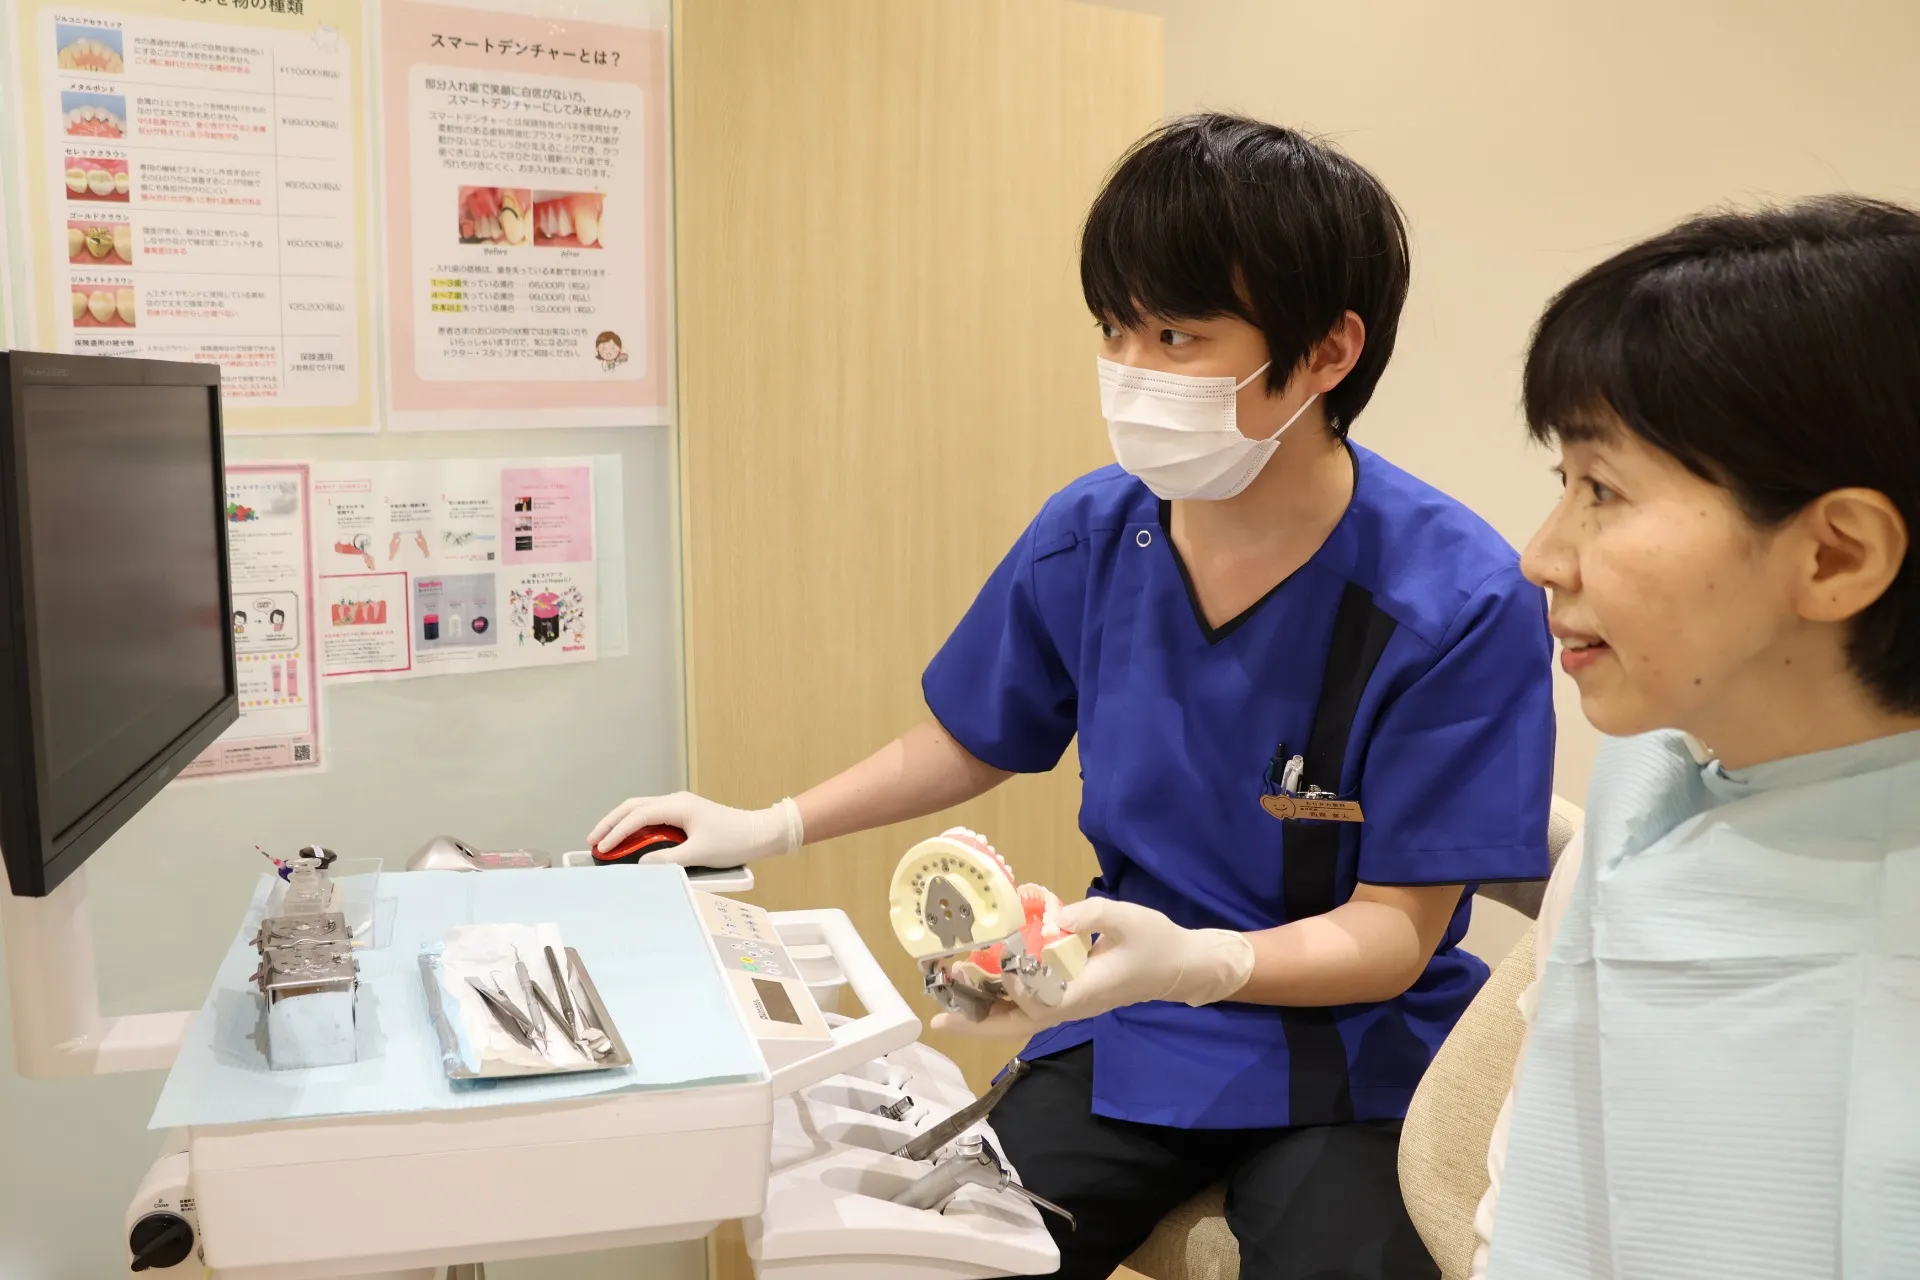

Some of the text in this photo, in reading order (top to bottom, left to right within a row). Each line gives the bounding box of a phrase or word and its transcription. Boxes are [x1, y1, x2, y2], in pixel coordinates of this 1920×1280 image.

[69, 83, 116, 93] メタルボンド
[69, 212, 130, 221] ゴールドクラウン
[483, 248, 508, 256] Before
[560, 250, 580, 258] After
